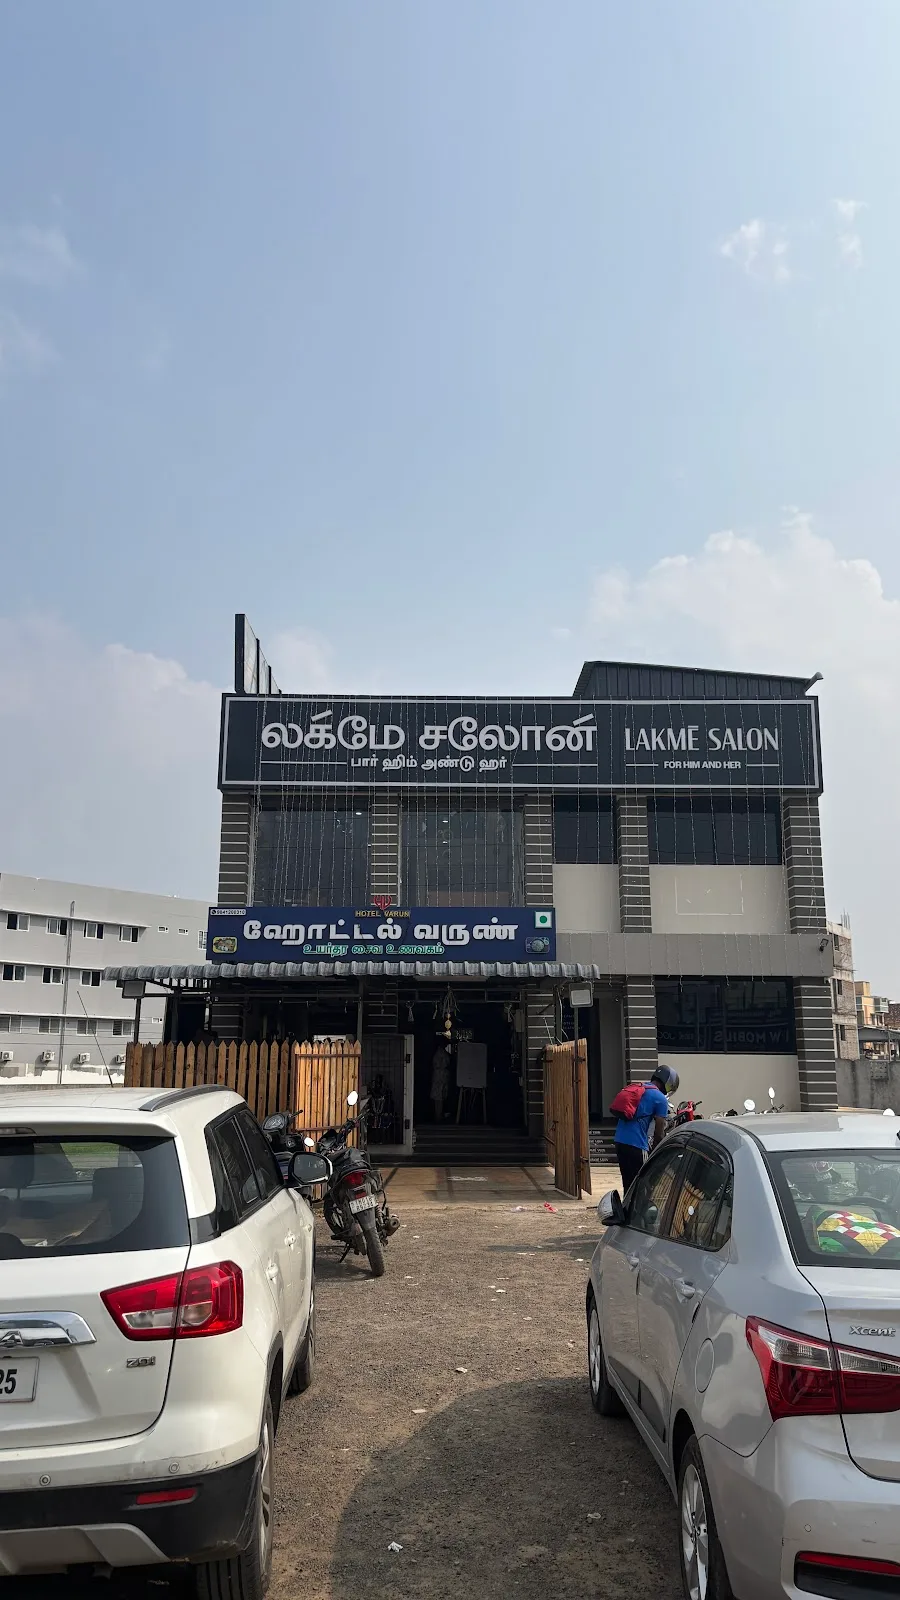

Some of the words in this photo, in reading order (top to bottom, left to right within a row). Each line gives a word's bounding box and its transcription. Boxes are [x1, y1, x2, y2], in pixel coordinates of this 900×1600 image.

[261, 709, 406, 750] லக்மே
[418, 713, 598, 751] சலோன்
[708, 727, 779, 751] SALON
[351, 754, 379, 767] பார்
[382, 754, 418, 772] ஹிம்
[420, 755, 475, 772] அண்டு
[479, 756, 508, 772] ஹர்
[663, 761, 682, 769] FOR
[683, 761, 700, 769] HIM
[701, 761, 722, 769] AND
[723, 761, 742, 769] HER
[243, 917, 402, 945] ஹோட்டல்
[414, 917, 518, 946] வருண்
[850, 1325, 896, 1337] Xcent
